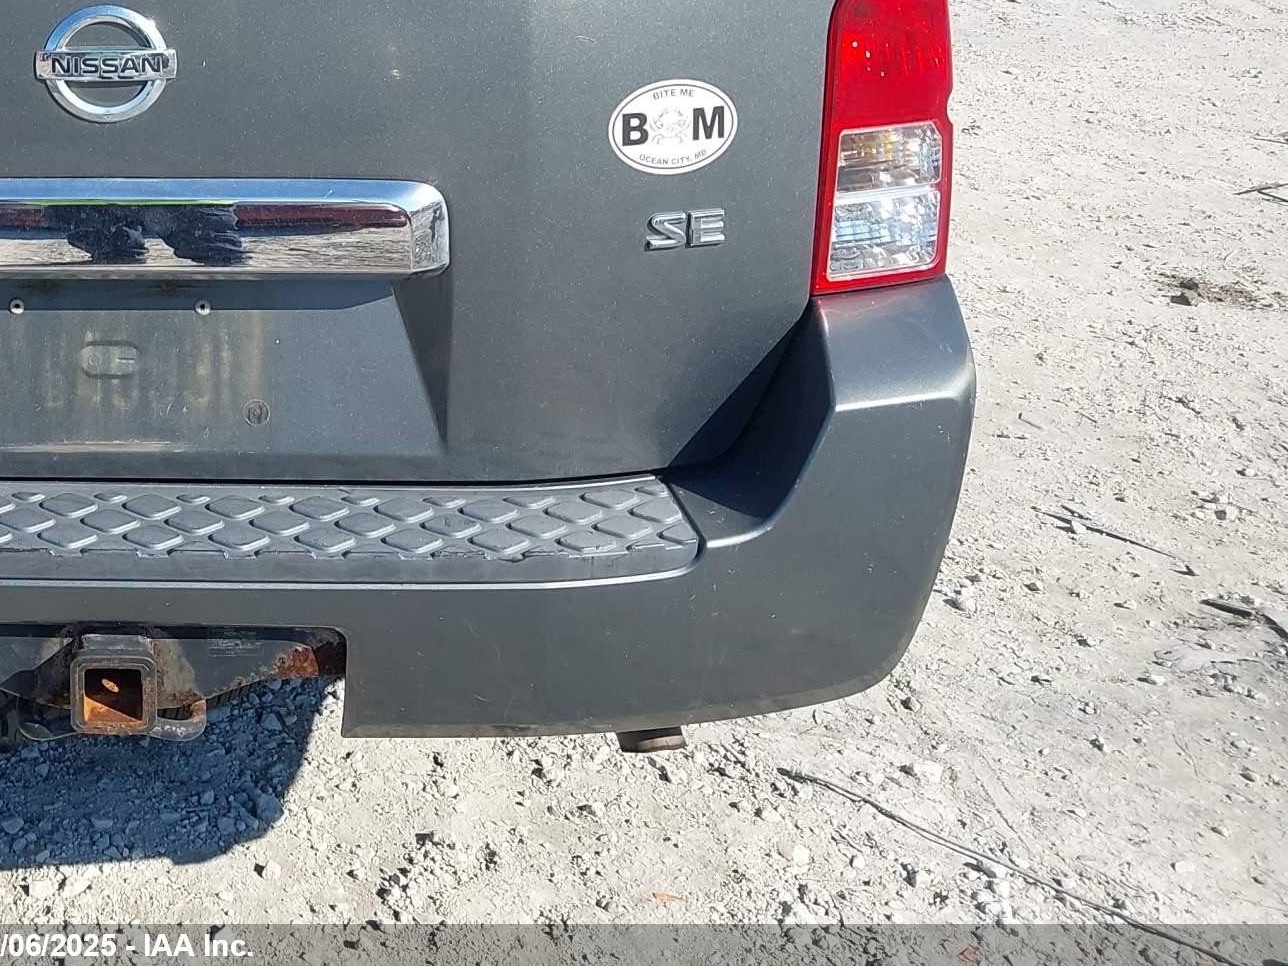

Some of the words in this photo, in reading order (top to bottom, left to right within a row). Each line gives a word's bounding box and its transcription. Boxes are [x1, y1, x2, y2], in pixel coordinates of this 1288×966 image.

[51, 55, 164, 76] NISSAN
[652, 88, 677, 101] BITE
[679, 88, 696, 98] ME
[621, 112, 649, 146] B
[692, 105, 725, 141] M
[639, 153, 669, 166] OCEAN
[671, 153, 693, 165] CITY,
[694, 148, 707, 160] MD
[644, 207, 726, 251] SE
